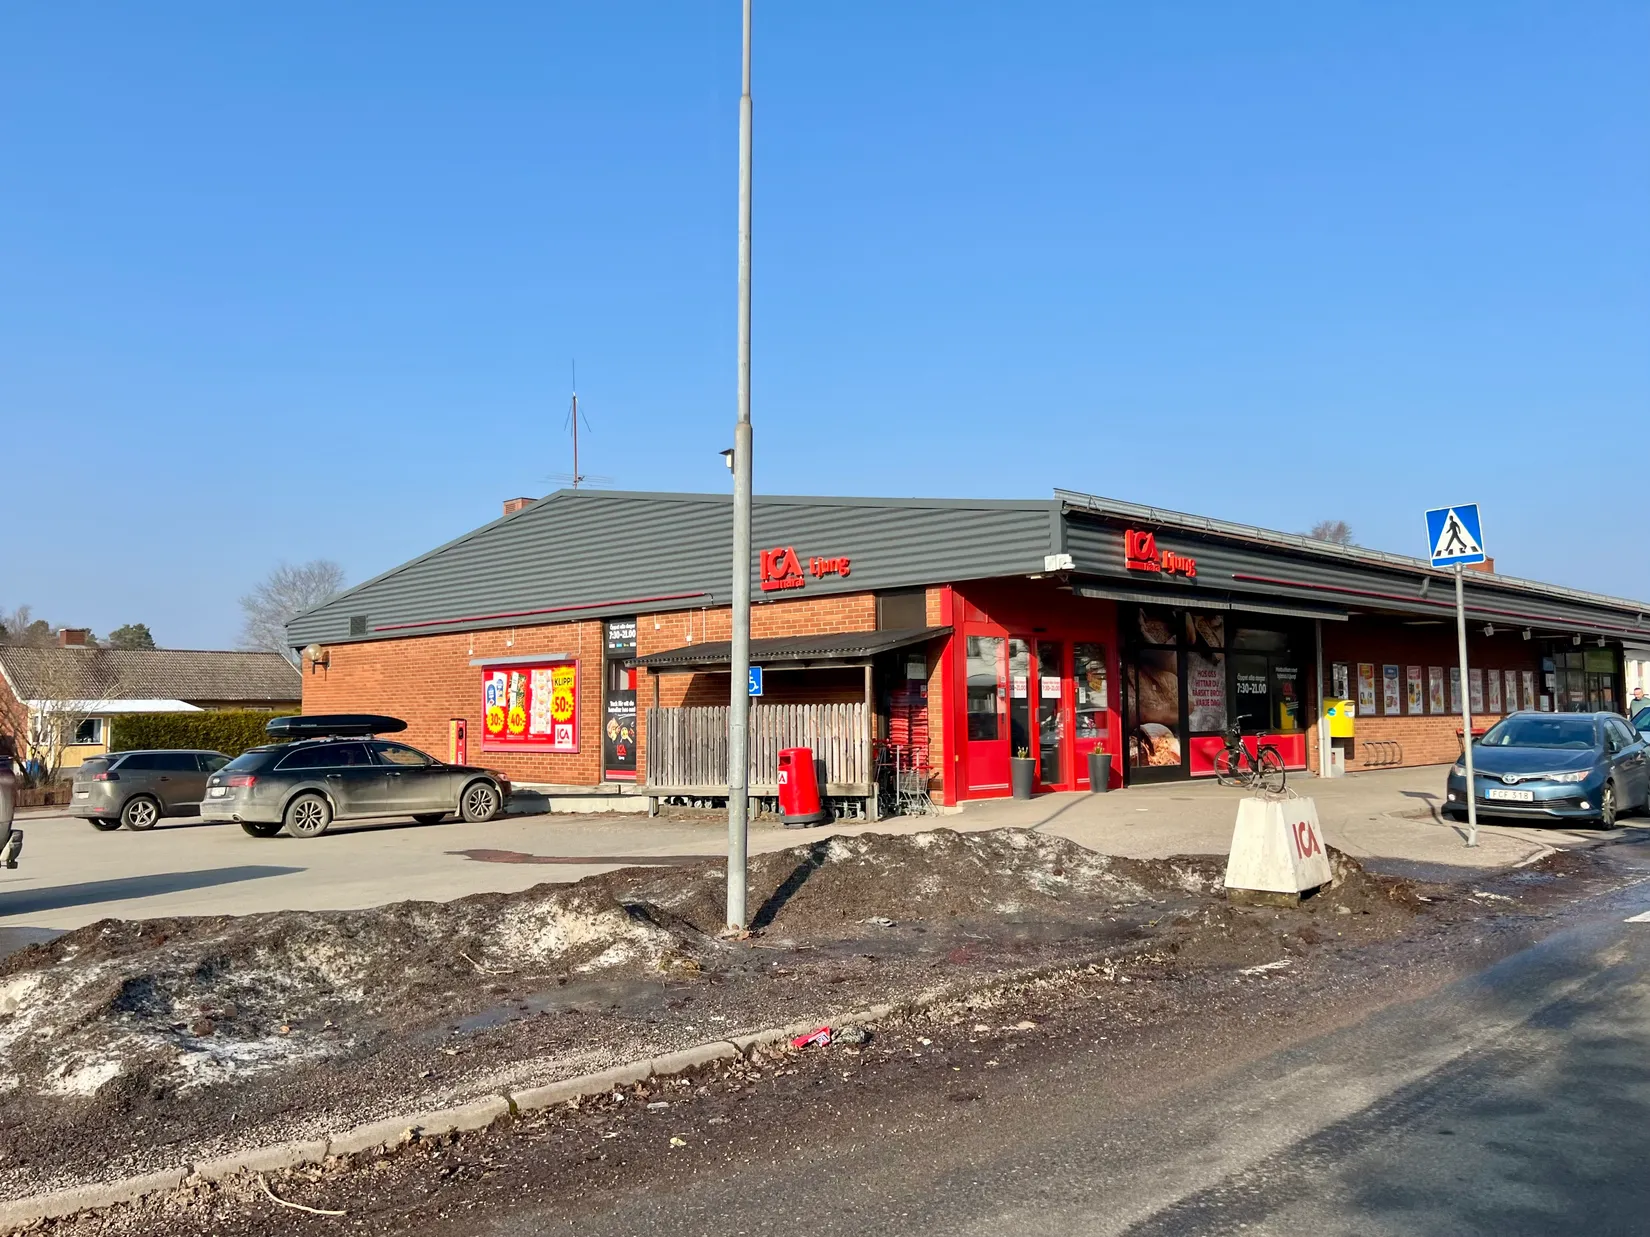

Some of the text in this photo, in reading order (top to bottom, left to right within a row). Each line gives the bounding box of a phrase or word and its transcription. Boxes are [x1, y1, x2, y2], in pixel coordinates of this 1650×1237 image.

[1125, 530, 1160, 561] ICA
[760, 546, 804, 580] ICA
[809, 557, 850, 578] Ljung
[1162, 550, 1197, 578] Ljung
[554, 677, 573, 686] KLIPP!
[556, 728, 570, 740] ICA
[1511, 791, 1529, 799] 318
[1292, 820, 1322, 860] ICA
